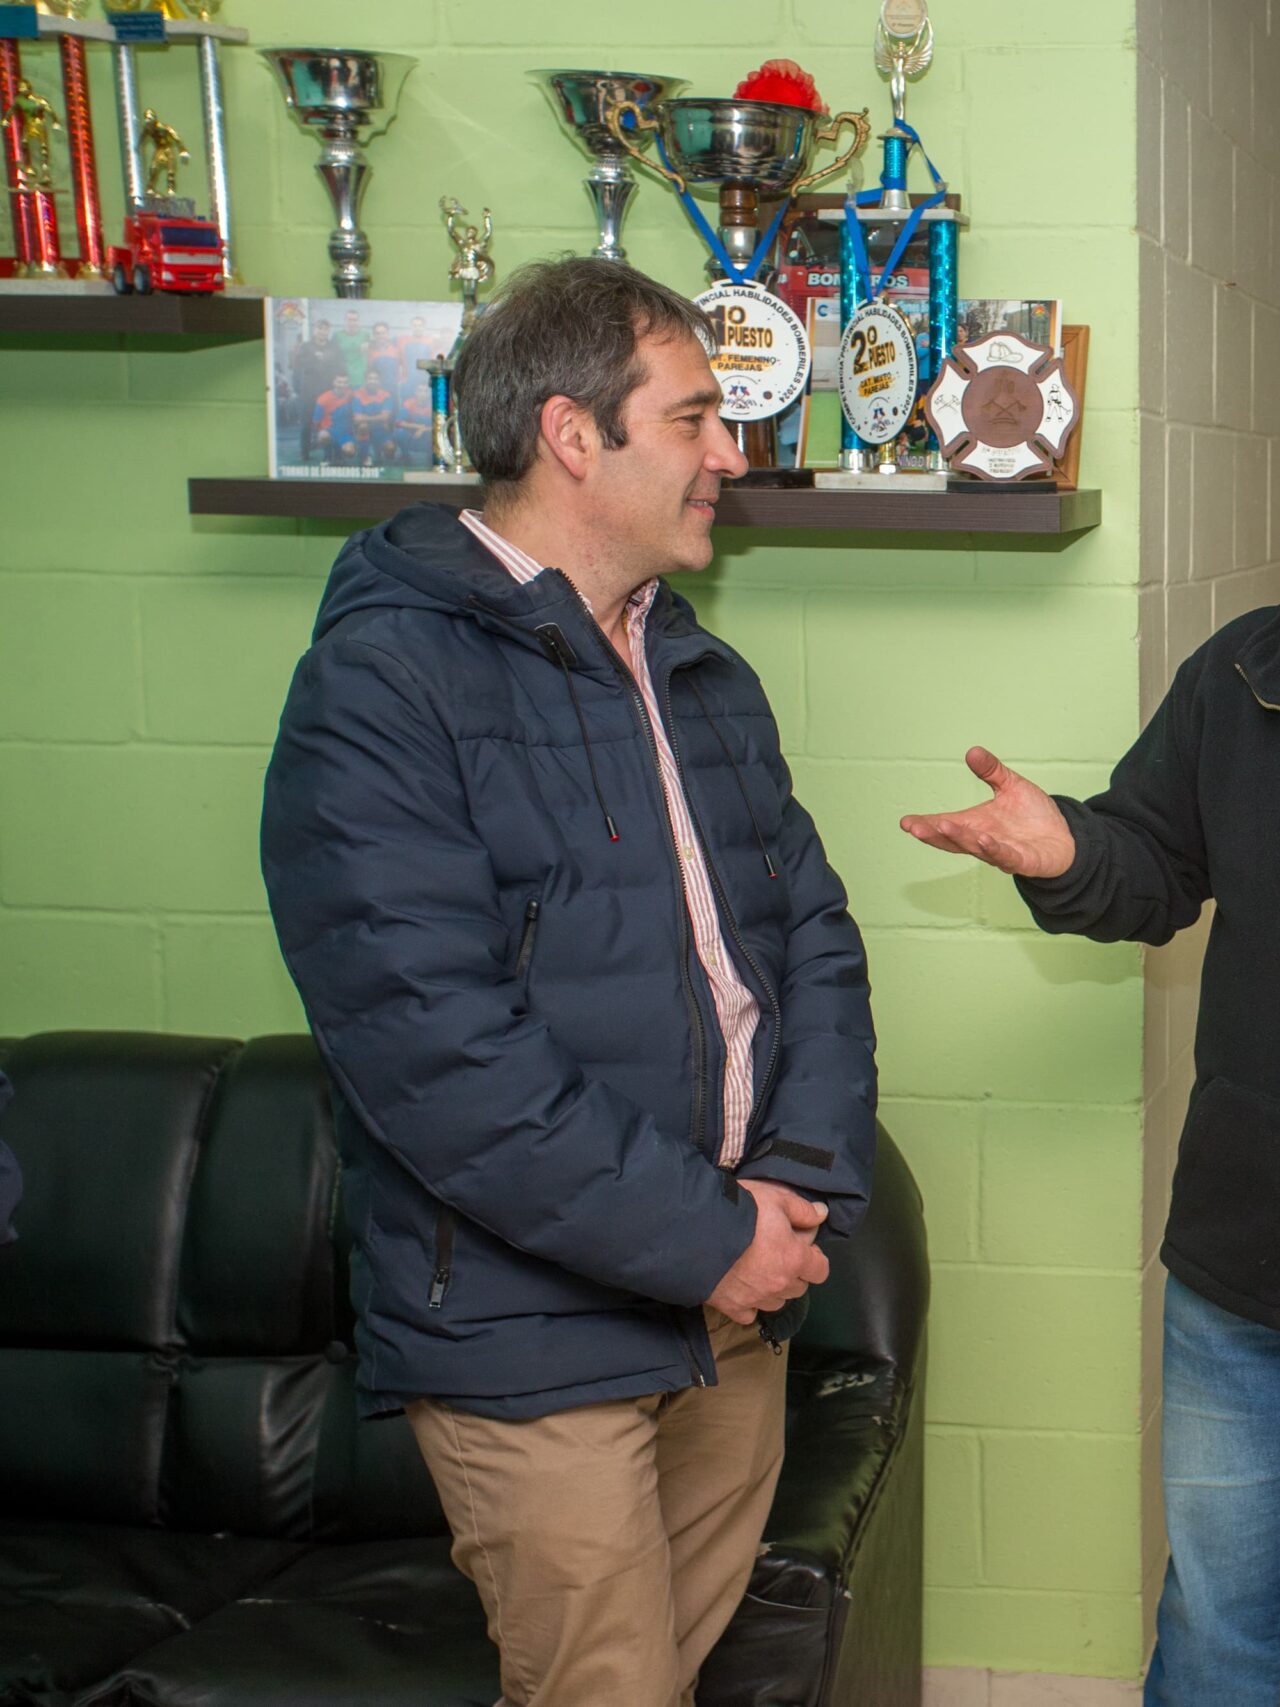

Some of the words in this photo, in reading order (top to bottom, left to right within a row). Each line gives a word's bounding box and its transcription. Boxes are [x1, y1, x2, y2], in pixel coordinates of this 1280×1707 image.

[807, 273, 909, 287] BOROS
[728, 326, 773, 348] PUESTO
[733, 289, 794, 324] HABILIDADES
[779, 384, 797, 403] 2024
[868, 341, 896, 369] PUESTO
[717, 362, 763, 372] PAREJAS
